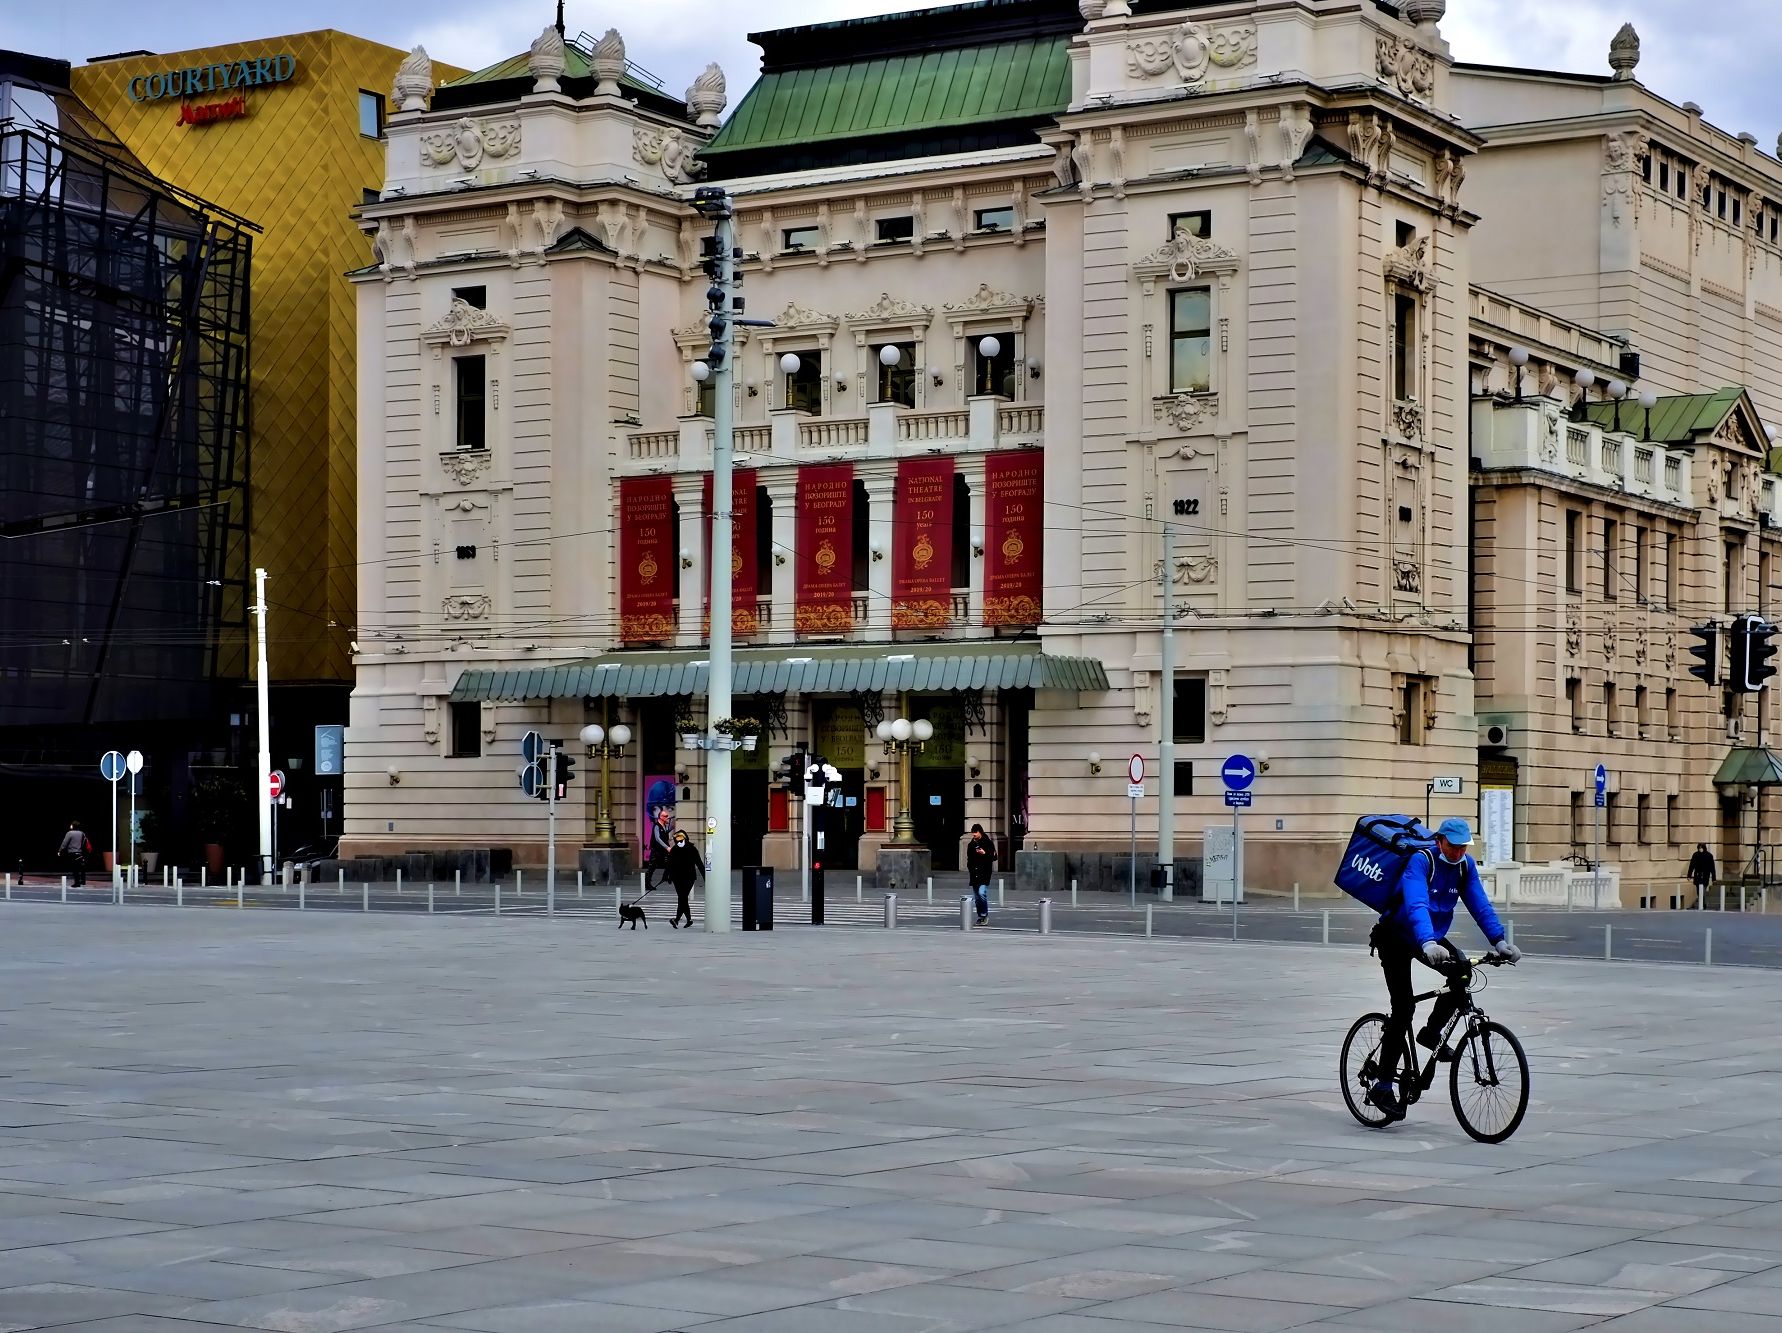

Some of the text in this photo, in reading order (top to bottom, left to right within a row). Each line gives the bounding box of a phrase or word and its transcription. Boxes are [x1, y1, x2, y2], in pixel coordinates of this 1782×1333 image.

[128, 54, 297, 103] COURTYARD
[992, 469, 1037, 479] НАРОДНО
[908, 475, 943, 485] NATIONAL
[992, 478, 1037, 489] ПОЗОРИШТЕ
[805, 481, 847, 490] НАРОДНО
[908, 485, 943, 494] THEATRE
[805, 491, 847, 500] ПОЗОРИШТЕ
[1000, 488, 1037, 498] БЕОГРАДУ
[813, 500, 847, 509] БЕОГРАДУ
[1005, 504, 1023, 515] 150
[917, 510, 934, 520] 150
[818, 515, 835, 526] 150
[640, 527, 656, 537] 150
[1439, 779, 1453, 788] WC
[1351, 853, 1384, 882] Wolt
